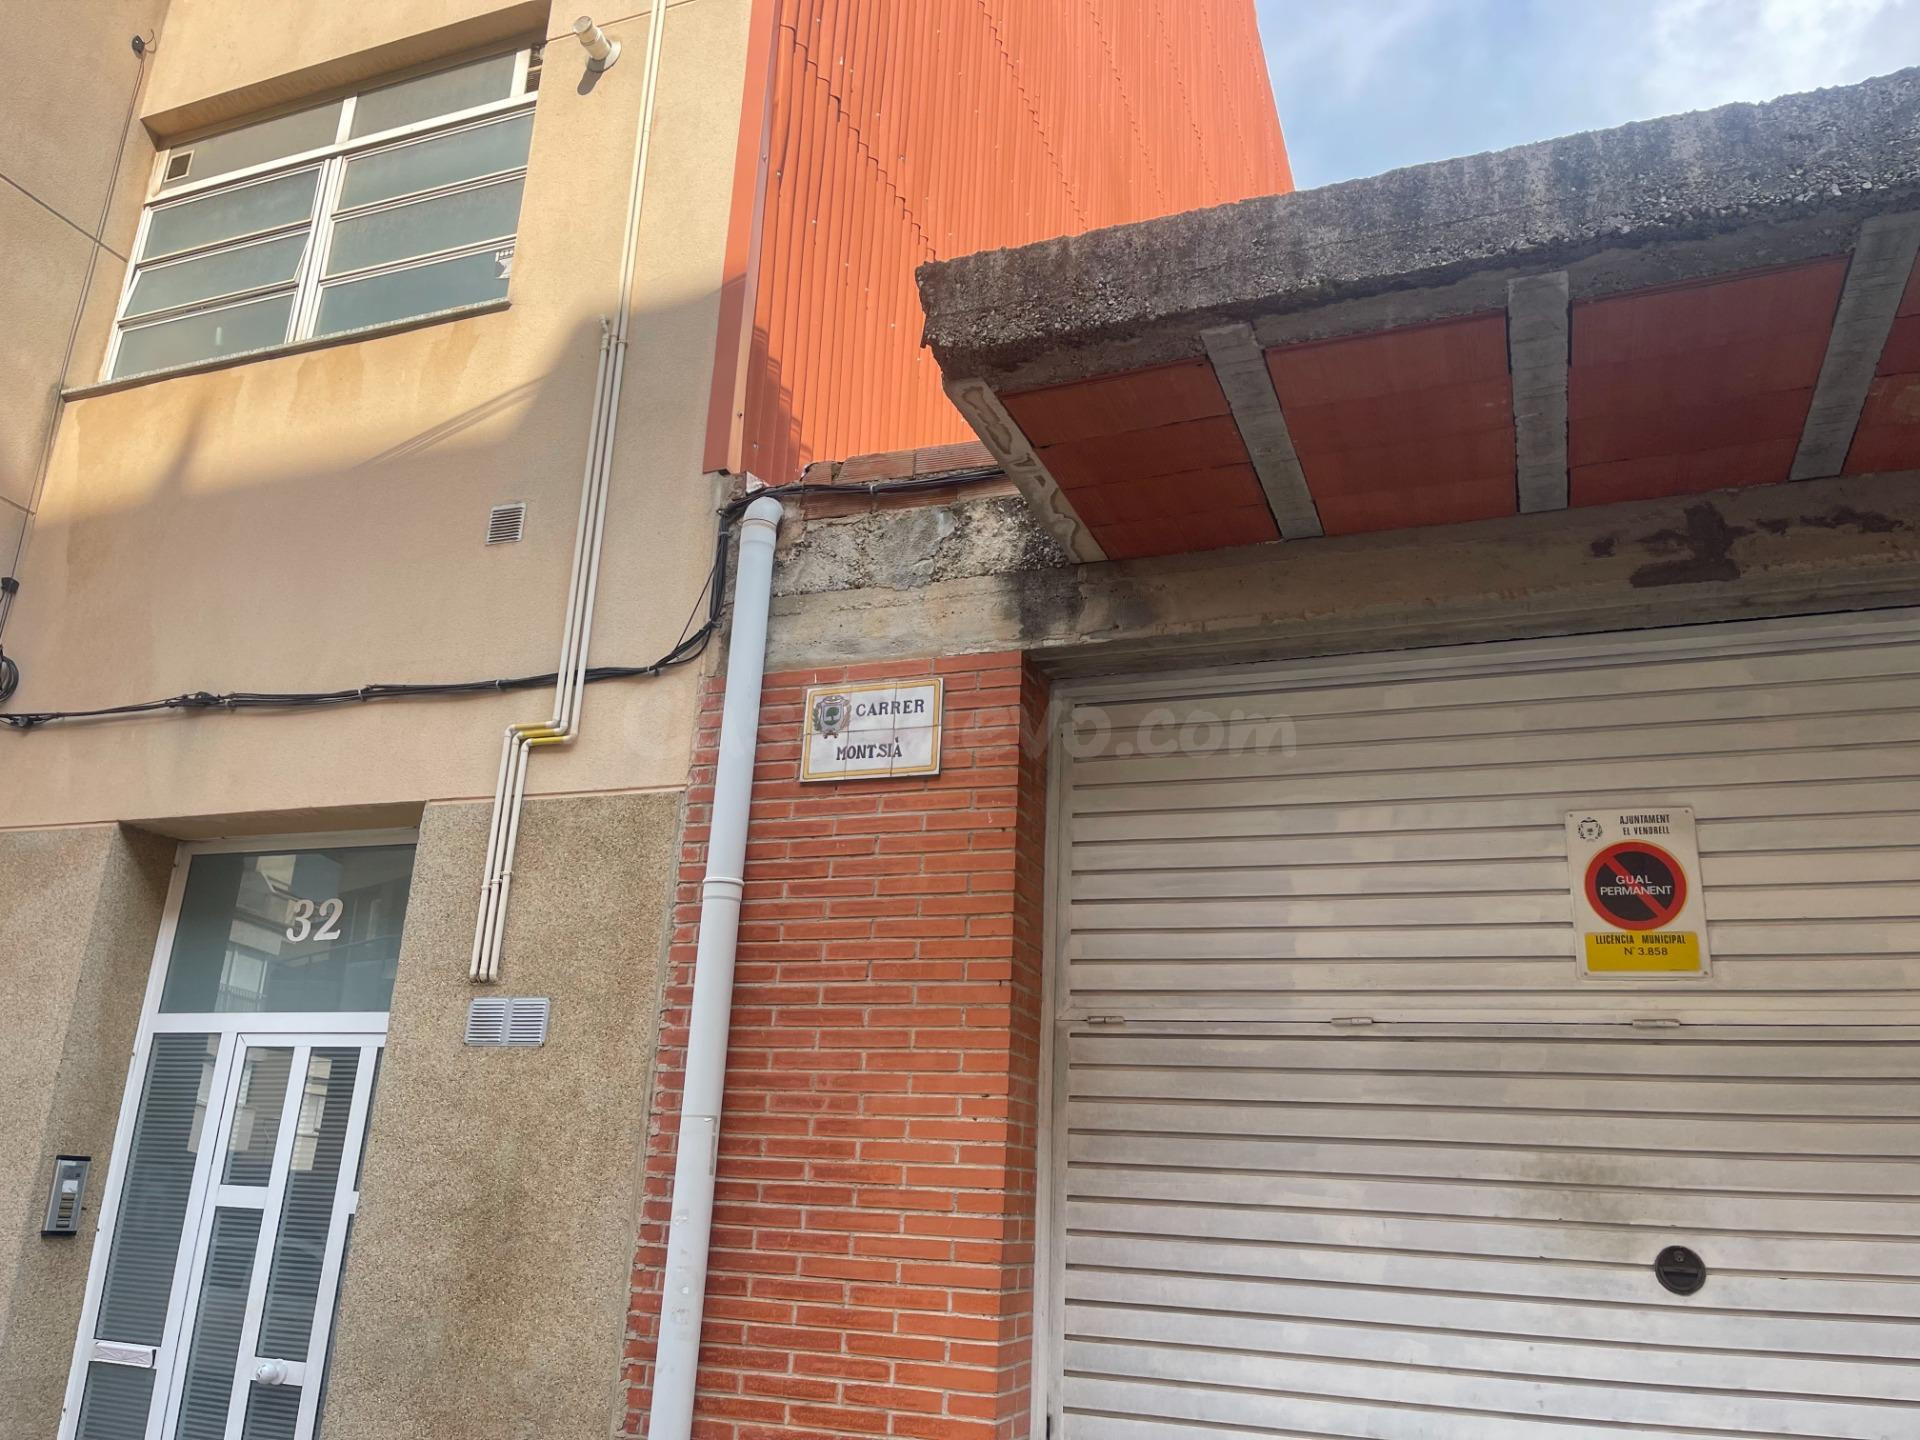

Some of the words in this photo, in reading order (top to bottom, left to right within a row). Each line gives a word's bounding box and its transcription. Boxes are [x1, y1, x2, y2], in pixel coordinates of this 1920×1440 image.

[855, 699, 925, 717] CARRER
[1619, 814, 1670, 825] AJUNTAMENT
[1622, 827, 1631, 836] EL
[1633, 825, 1670, 835] VENDRELL
[1615, 875, 1653, 885] GUAL
[1600, 885, 1672, 896] PERMANENT
[286, 898, 344, 942] 32
[1641, 934, 1686, 945] MUNICIPAL
[1638, 946, 1668, 956] 3.858
